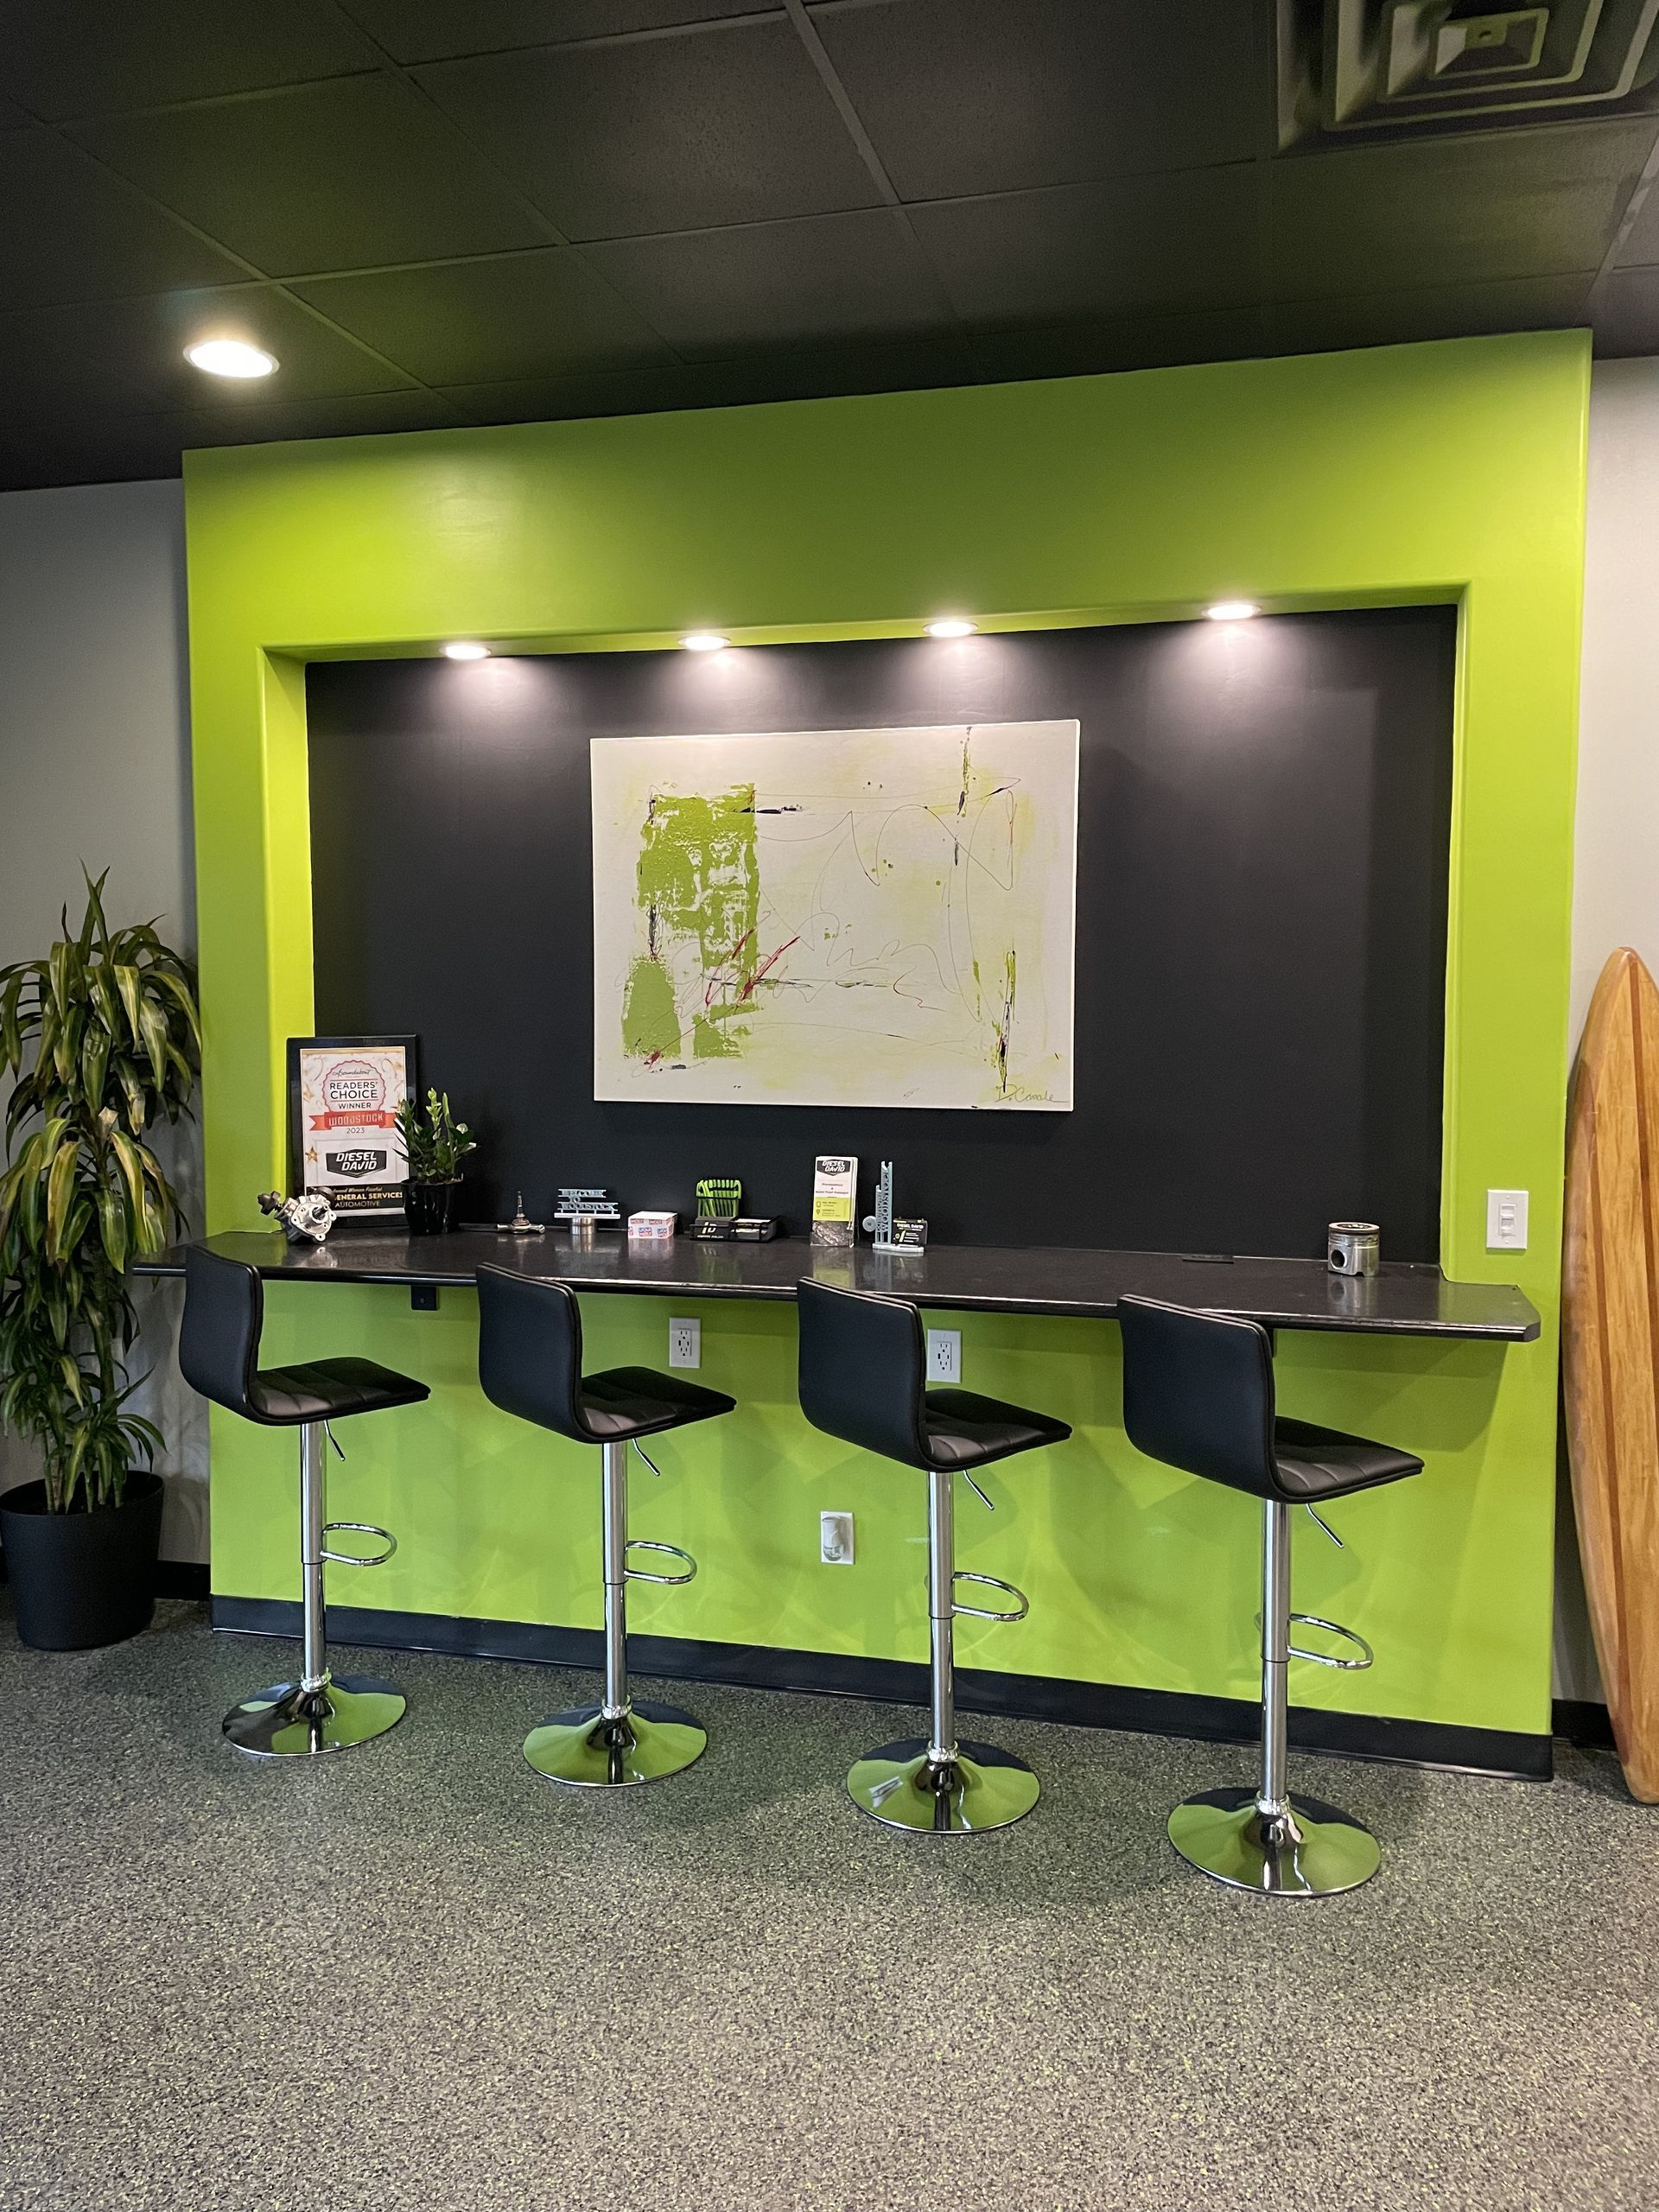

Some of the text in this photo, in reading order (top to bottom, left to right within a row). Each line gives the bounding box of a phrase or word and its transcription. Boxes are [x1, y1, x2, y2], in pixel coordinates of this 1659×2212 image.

[330, 1090, 378, 1099] CHOICE
[328, 1113, 383, 1126] WOODSTOCK
[336, 1151, 377, 1163] DIESEL
[341, 1160, 377, 1171] DAVID
